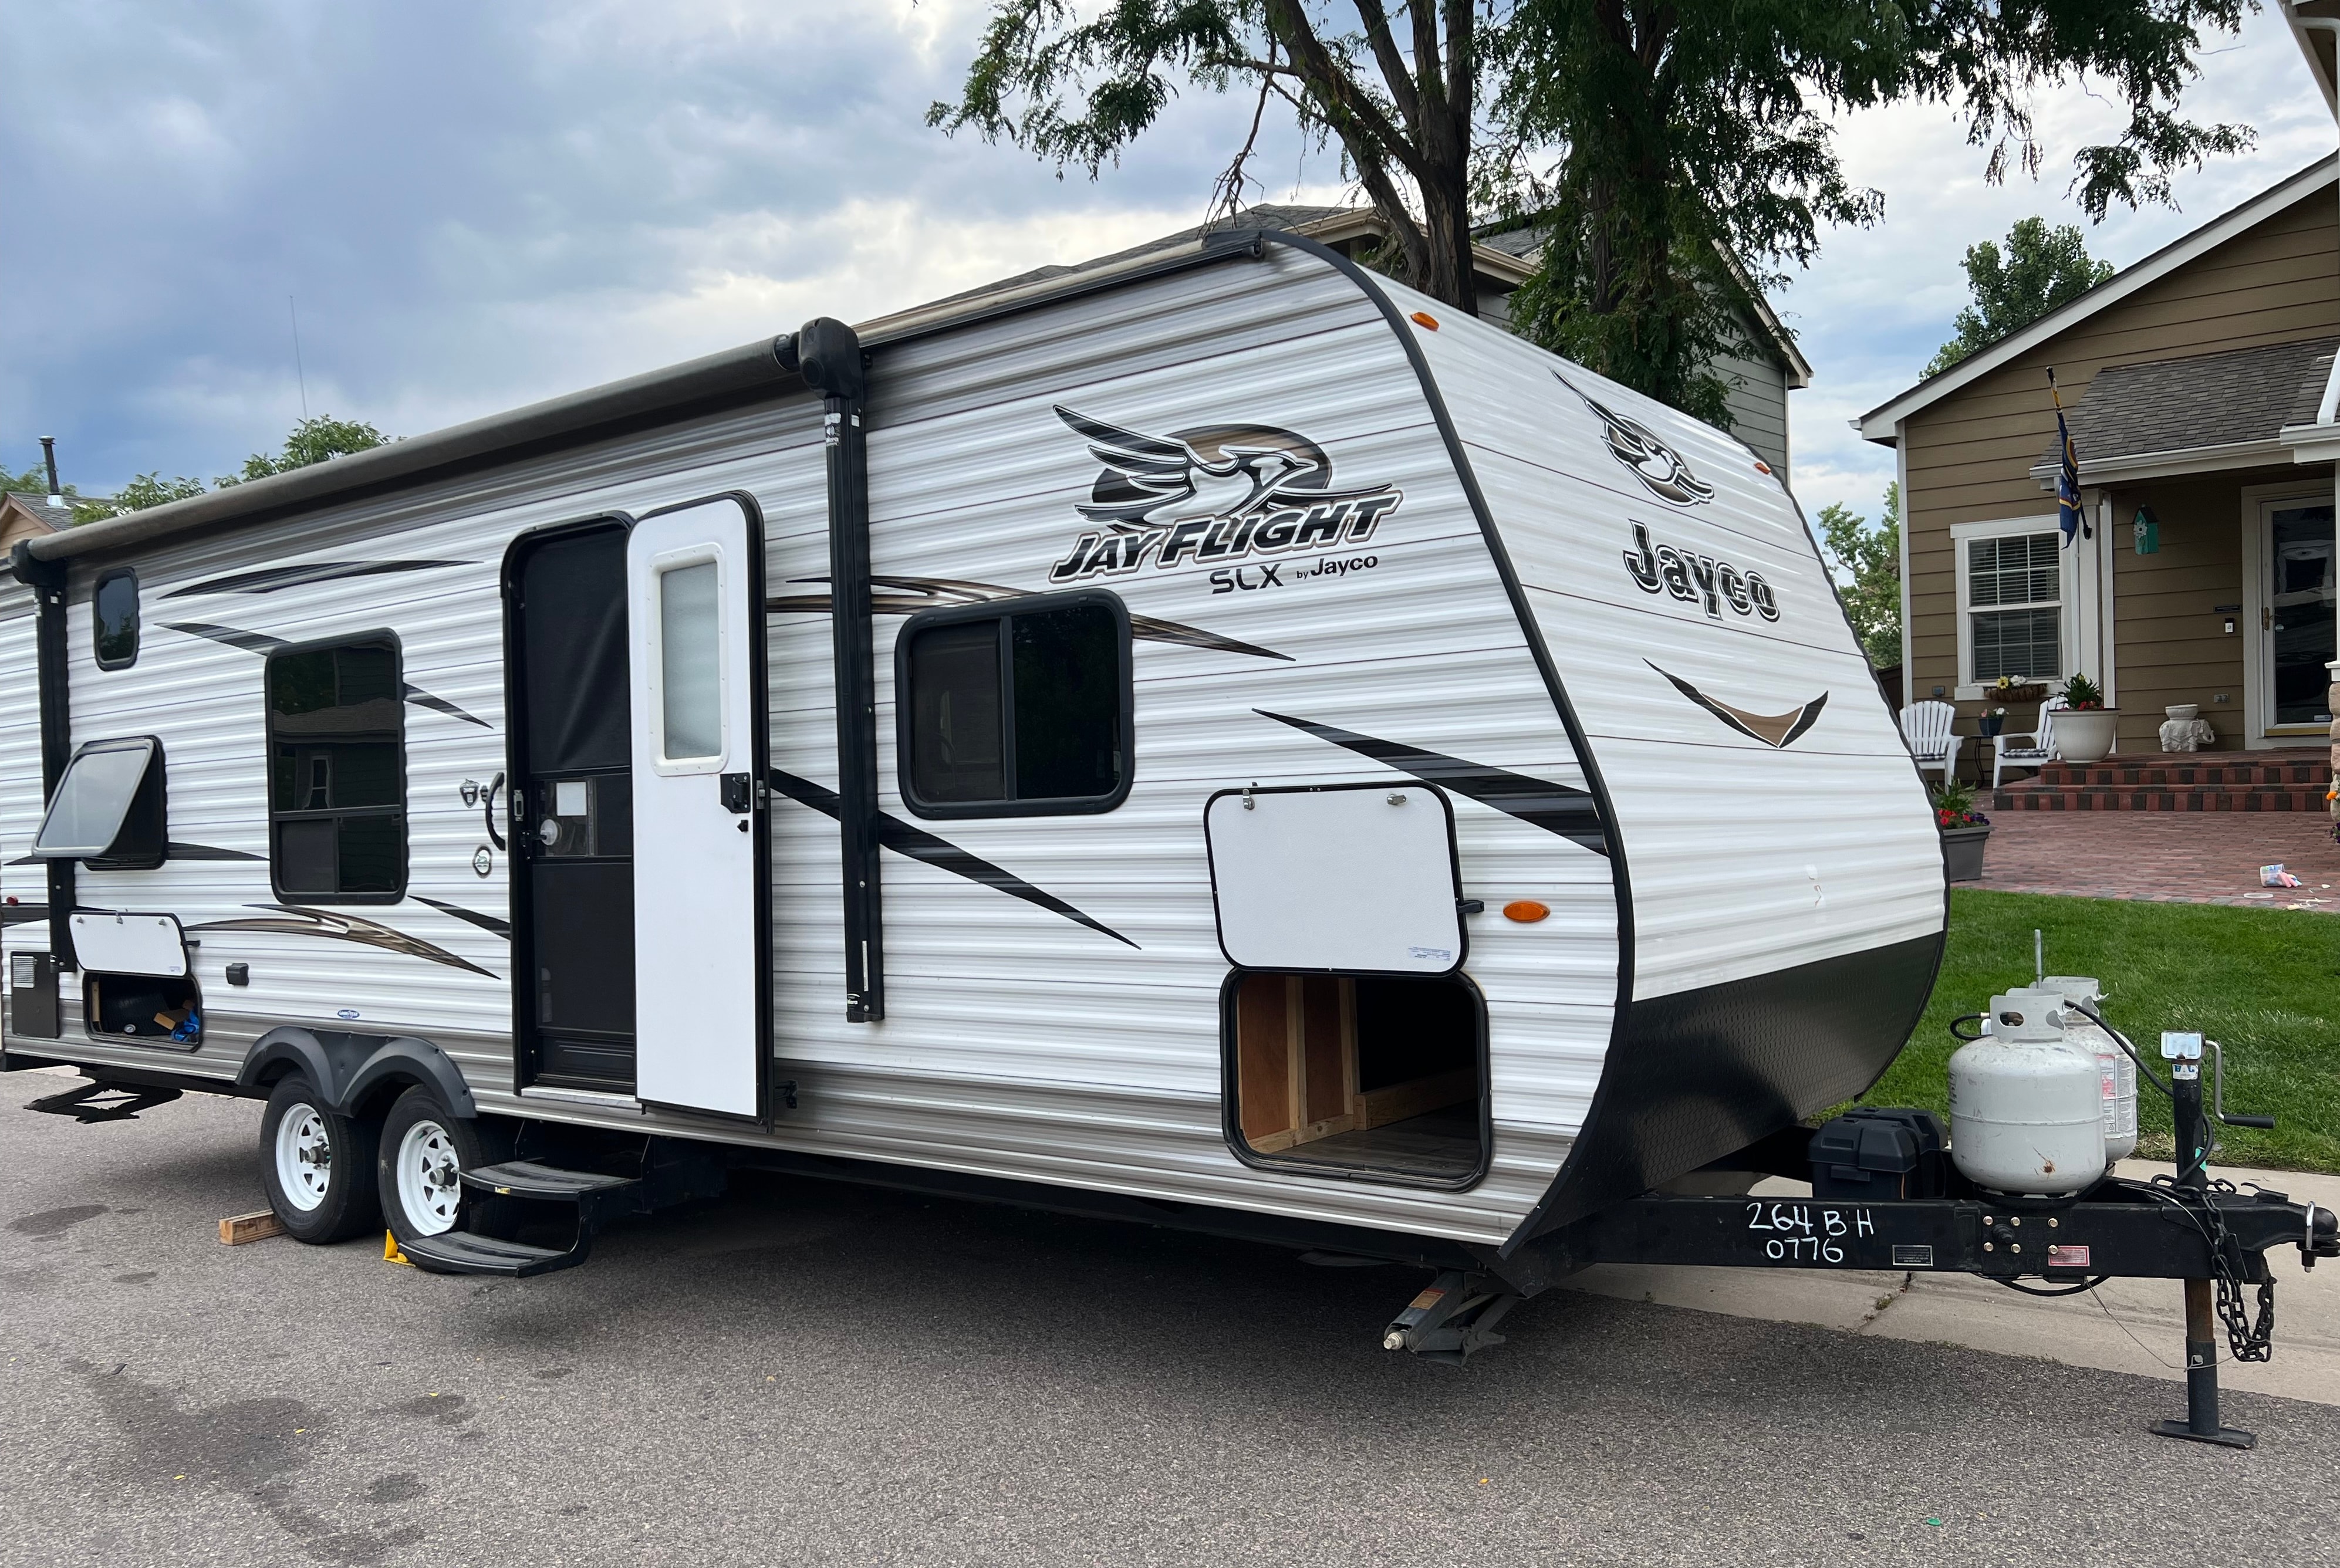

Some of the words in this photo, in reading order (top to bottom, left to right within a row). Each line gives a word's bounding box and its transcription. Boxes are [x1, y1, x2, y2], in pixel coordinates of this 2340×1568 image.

[1049, 528, 1169, 584] JAY
[1155, 491, 1403, 569] FLIGHT
[1209, 563, 1284, 594] SLX
[1296, 570, 1309, 580] by
[1311, 556, 1378, 577] Jayco
[1623, 518, 1780, 623] Jayco
[1747, 1202, 1814, 1235] 264
[1767, 1236, 1843, 1263] 0776
